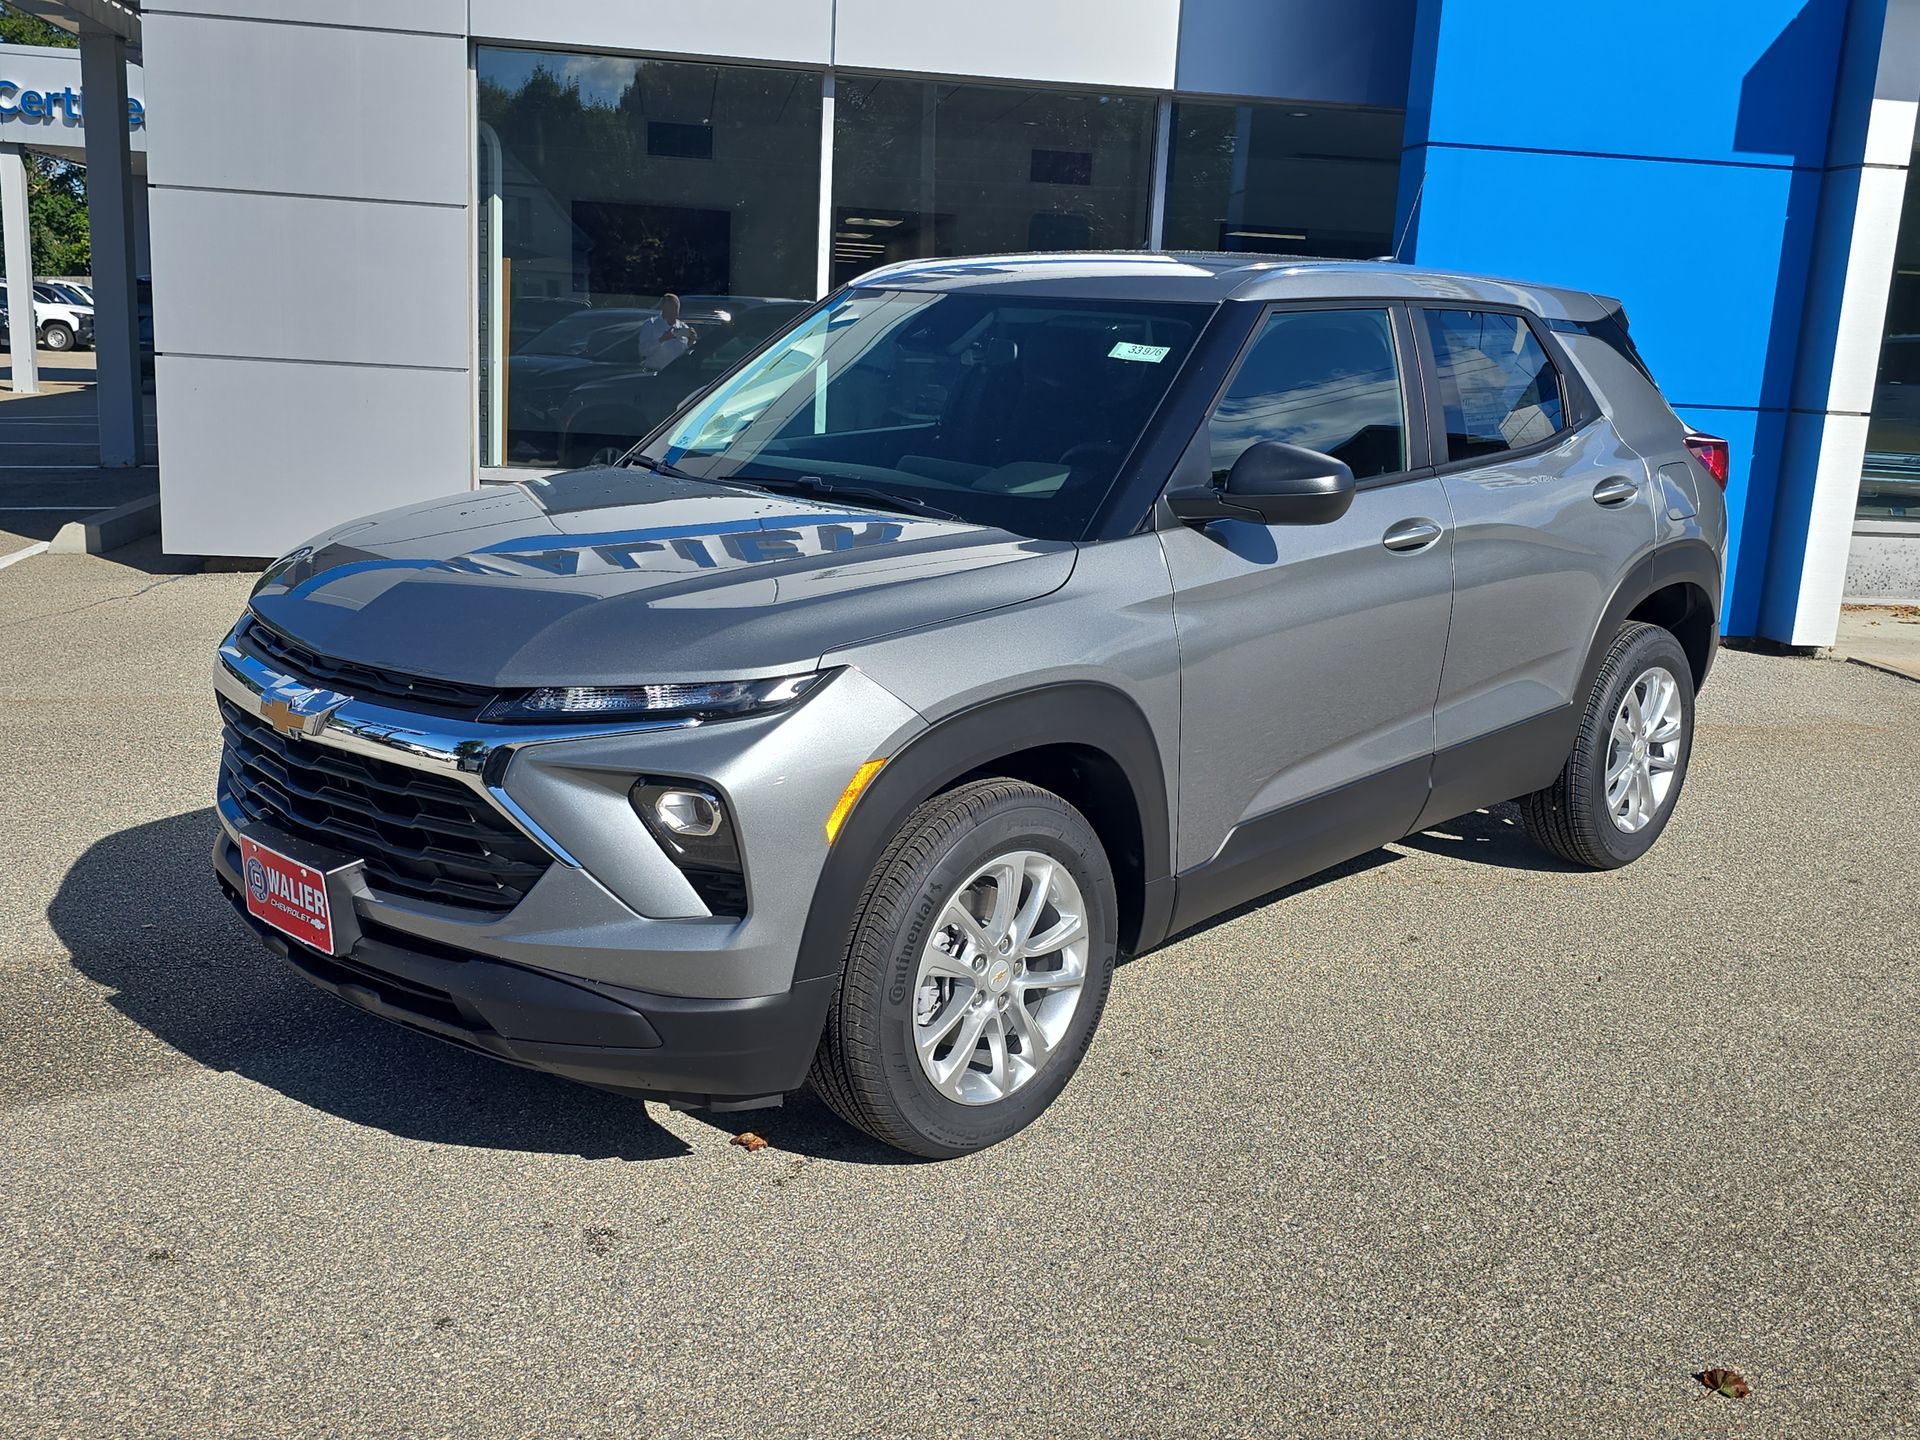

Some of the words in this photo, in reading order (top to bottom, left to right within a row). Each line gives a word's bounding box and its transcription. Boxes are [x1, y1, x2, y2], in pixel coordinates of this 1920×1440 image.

[1128, 345, 1163, 356] 33976
[266, 866, 326, 918] WALIER
[270, 898, 311, 923] CHEVROLET
[888, 893, 935, 1005] Continental
